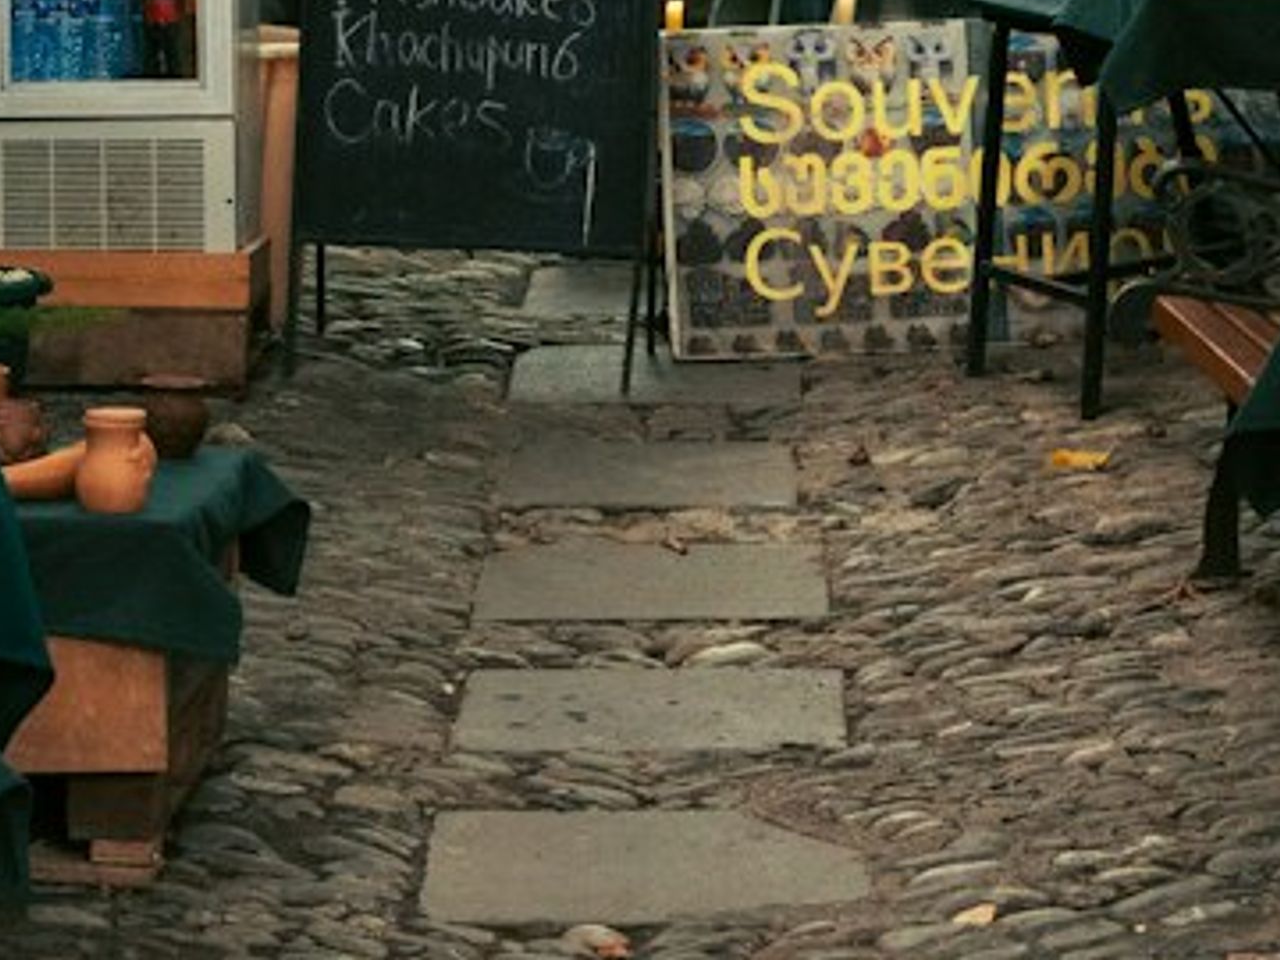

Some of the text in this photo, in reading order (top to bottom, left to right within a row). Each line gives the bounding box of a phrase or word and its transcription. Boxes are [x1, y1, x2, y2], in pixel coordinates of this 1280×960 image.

[551, 31, 582, 80] 6
[324, 78, 511, 143] Cakes
[739, 63, 1211, 144] Souven
[745, 227, 1176, 318] Сувенир
